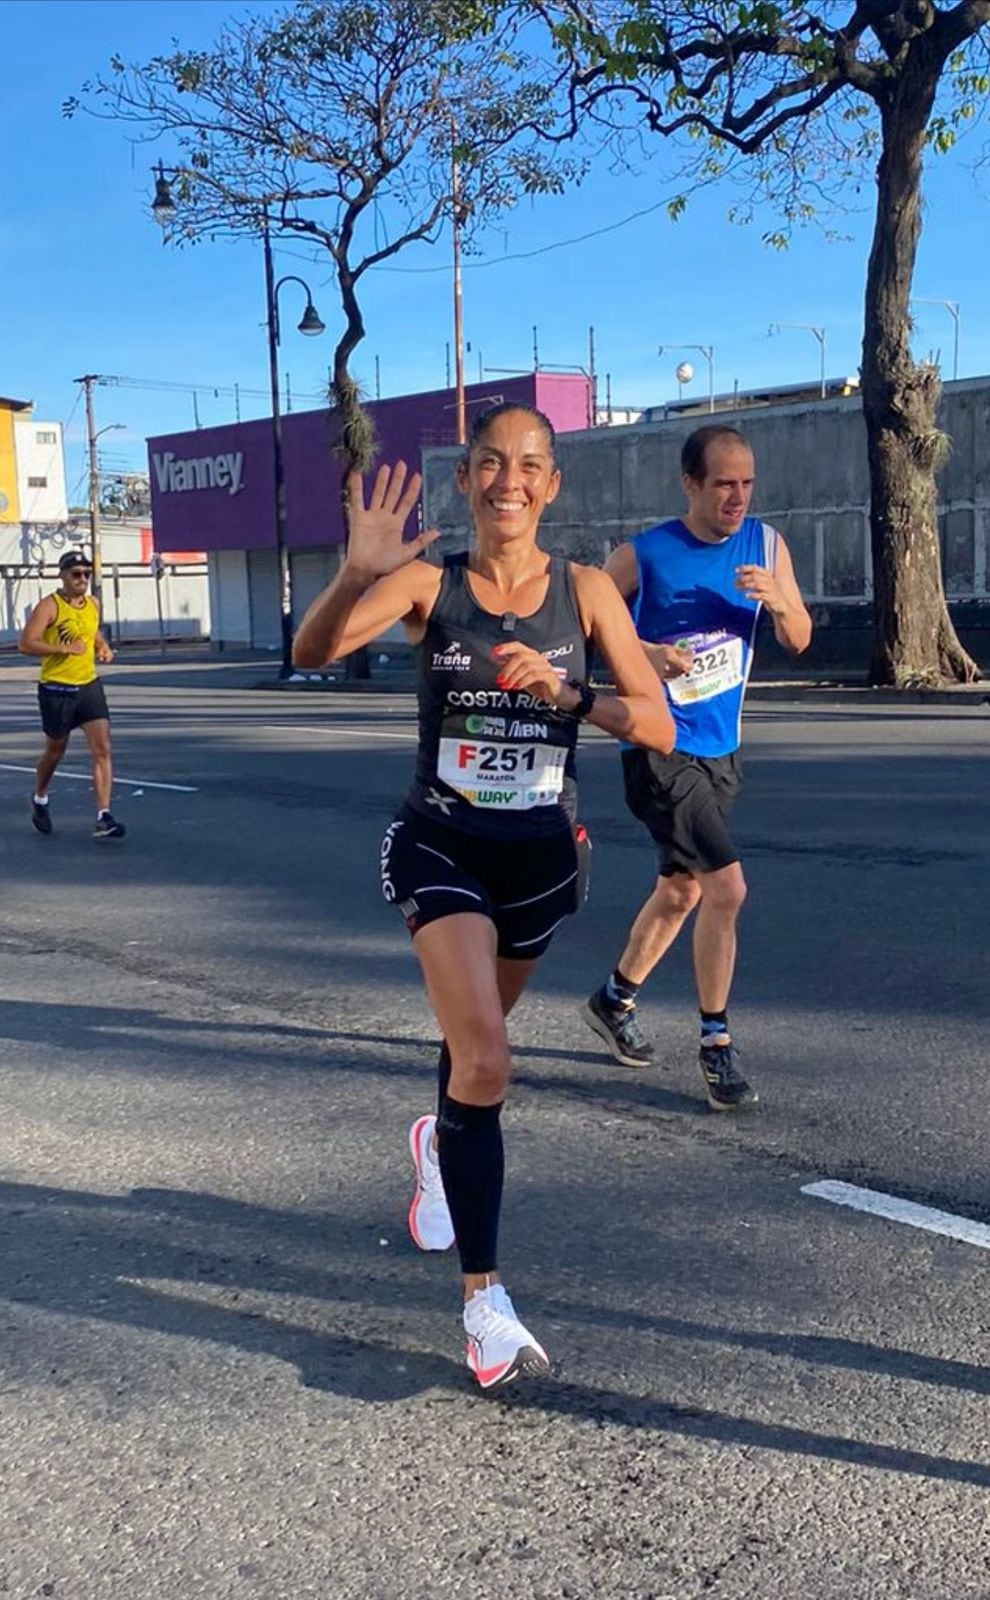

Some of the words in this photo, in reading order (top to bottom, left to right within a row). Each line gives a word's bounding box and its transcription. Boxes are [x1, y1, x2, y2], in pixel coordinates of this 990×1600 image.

[153, 452, 243, 495] Vianney
[432, 652, 472, 666] Traña
[684, 648, 729, 678] 322
[447, 690, 512, 709] COSTA
[458, 744, 537, 772] F251
[463, 787, 517, 804] UBWAY
